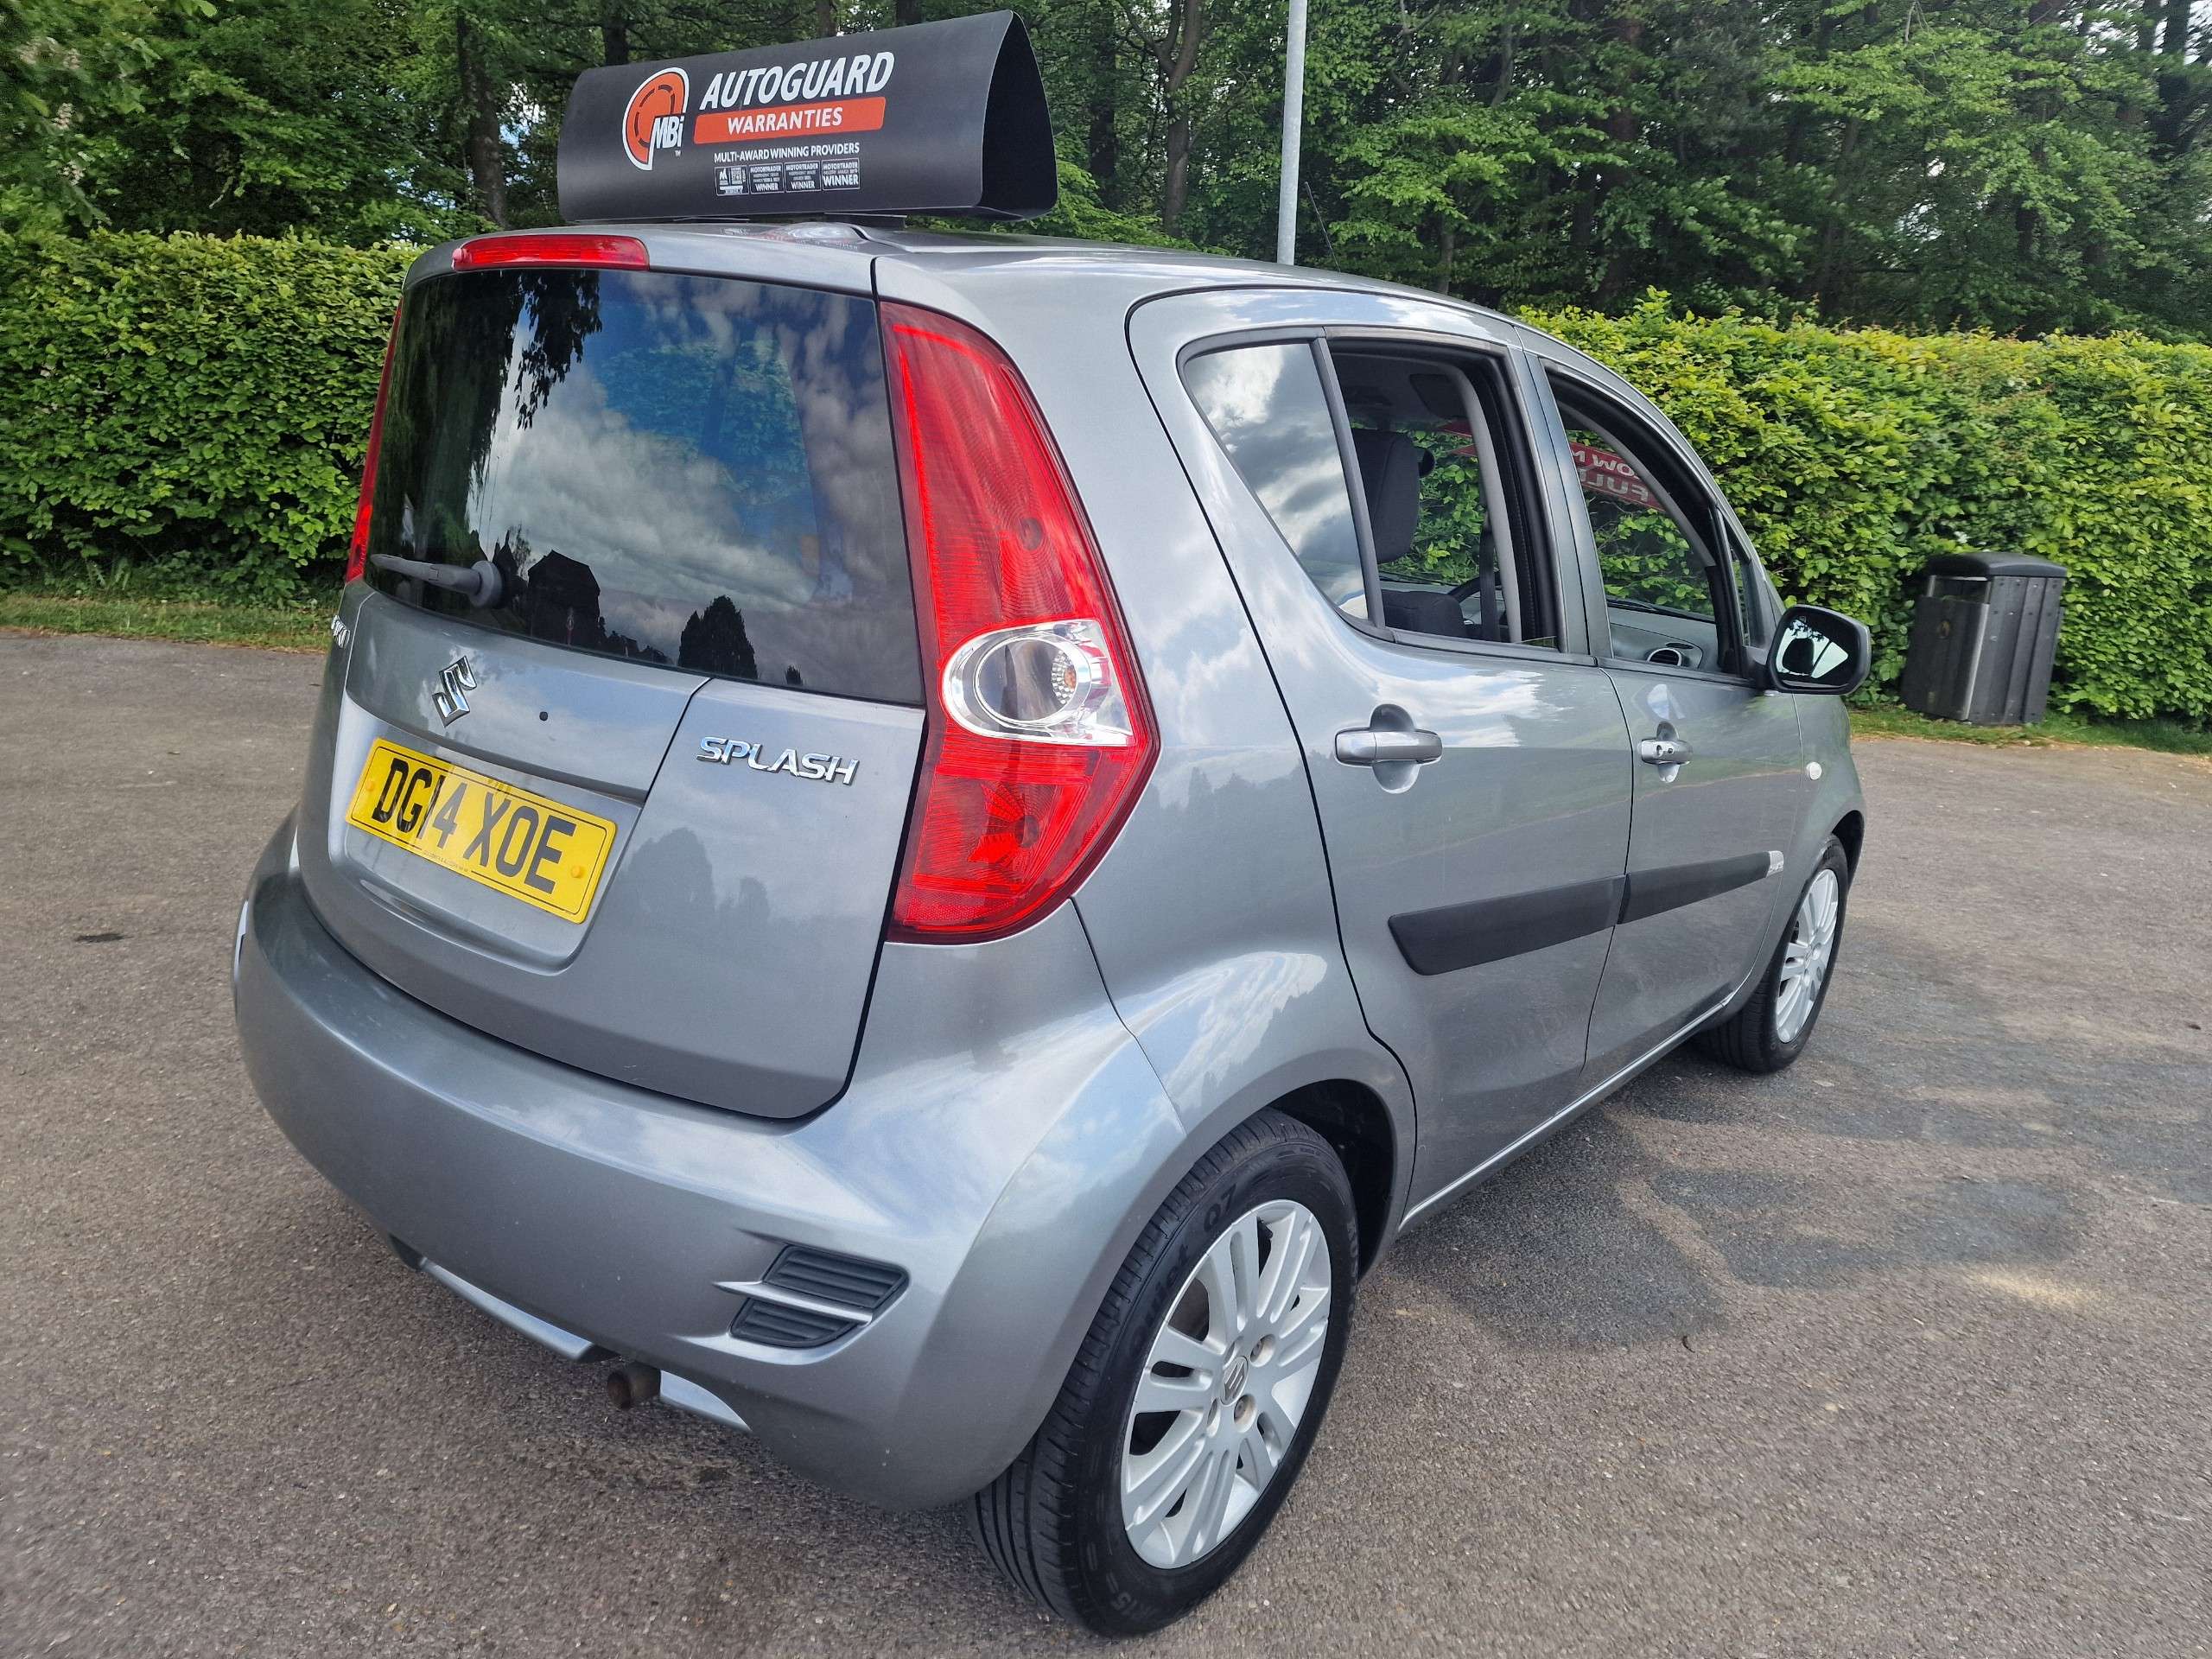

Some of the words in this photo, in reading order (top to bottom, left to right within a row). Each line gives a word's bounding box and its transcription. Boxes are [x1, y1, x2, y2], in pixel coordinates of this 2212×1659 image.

[699, 52, 894, 111] AUTOGUARD
[728, 107, 843, 135] WARRANTIES
[714, 149, 769, 163] MULTI-AWARD
[770, 146, 810, 160] WINNING
[810, 143, 860, 156] PROVIDERS
[755, 182, 779, 192] WINNER
[791, 181, 815, 189] WINNER
[823, 175, 859, 187] WINNER
[696, 736, 860, 786] SPLASH
[372, 757, 467, 849] DG14
[463, 791, 576, 894] XOE
